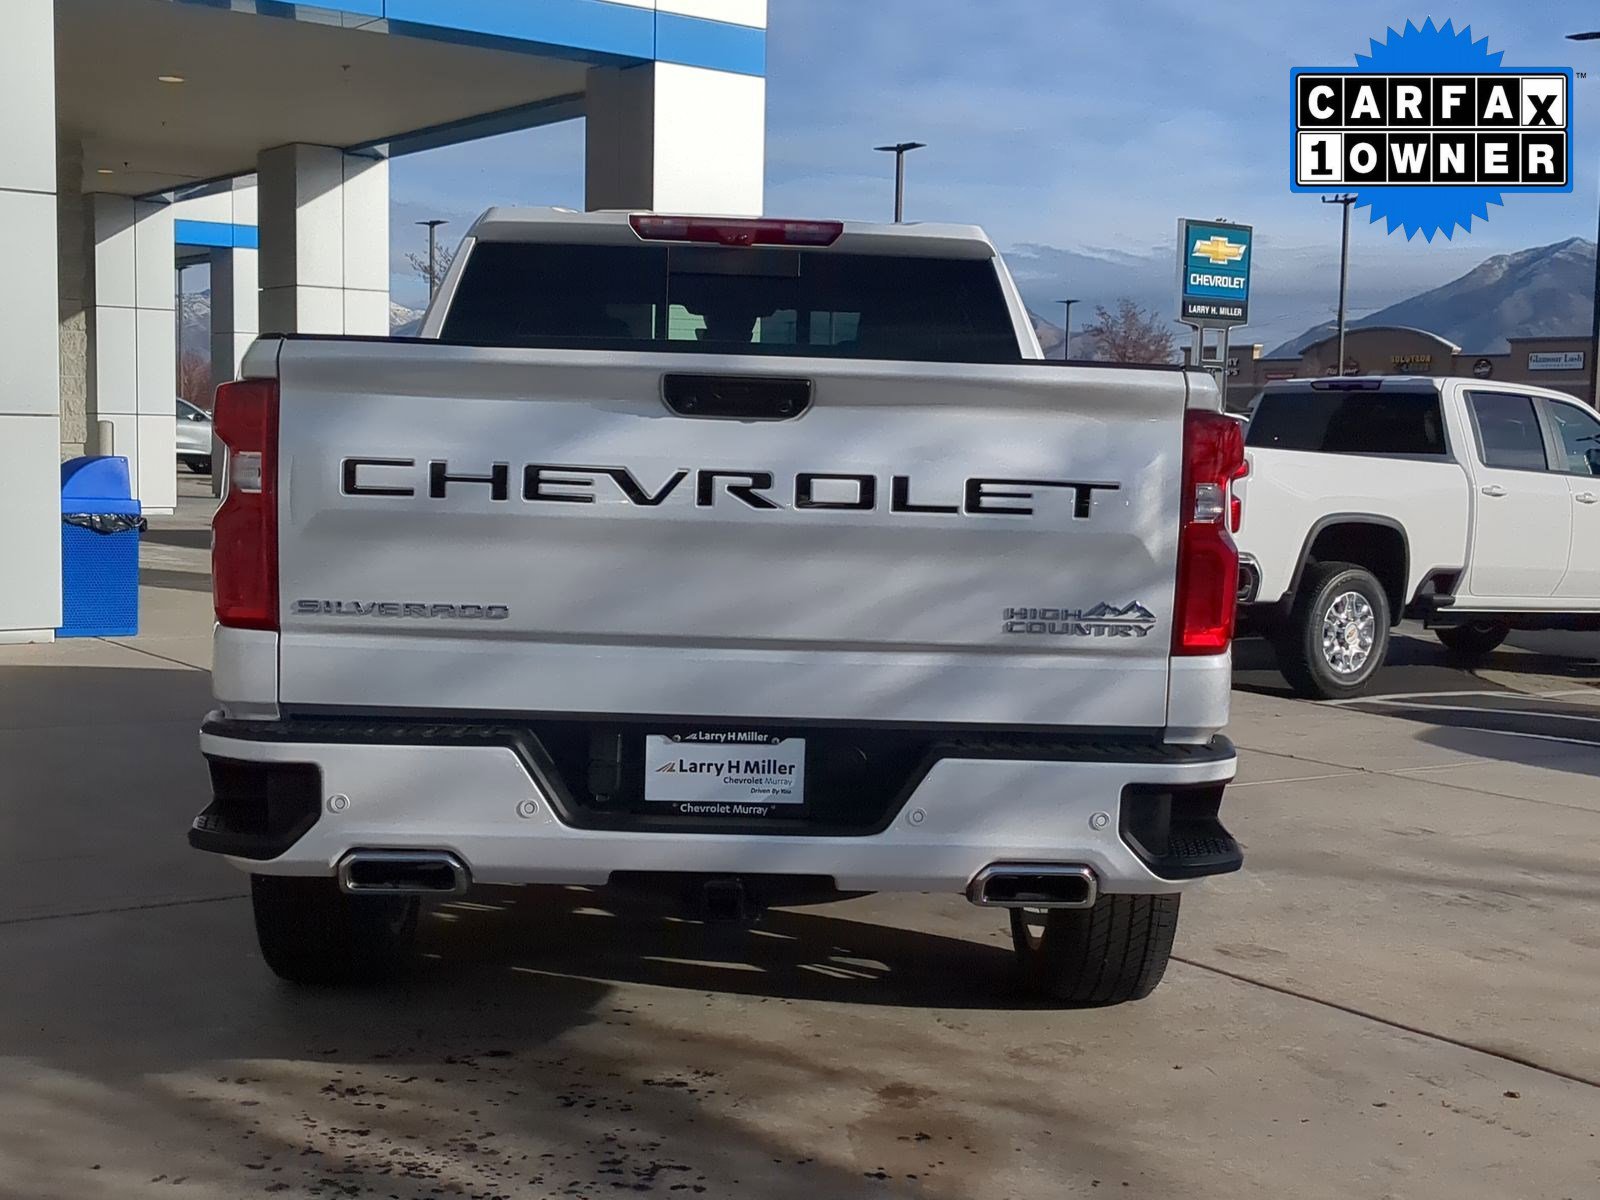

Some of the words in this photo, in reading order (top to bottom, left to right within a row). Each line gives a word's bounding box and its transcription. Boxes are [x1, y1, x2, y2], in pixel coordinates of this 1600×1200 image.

[1190, 273, 1246, 289] CHEVROLET
[1188, 304, 1210, 315] LARRY
[1211, 306, 1218, 315] H.
[1219, 307, 1242, 316] MILLER
[340, 456, 1121, 520] CHEVROLET
[292, 599, 510, 620] SILVERADO
[1002, 607, 1084, 621] HIGH
[1002, 620, 1156, 638] COUNTRY
[699, 731, 726, 744] Larry
[727, 732, 736, 742] H
[737, 732, 769, 742] Miller
[679, 759, 725, 777] Larry
[728, 760, 740, 774] H
[743, 759, 796, 775] Miller
[723, 776, 763, 785] Chevrolet
[764, 778, 793, 787] Murray
[750, 787, 771, 795] Driven
[680, 802, 732, 815] Chevrolet
[732, 804, 769, 817] Murray
